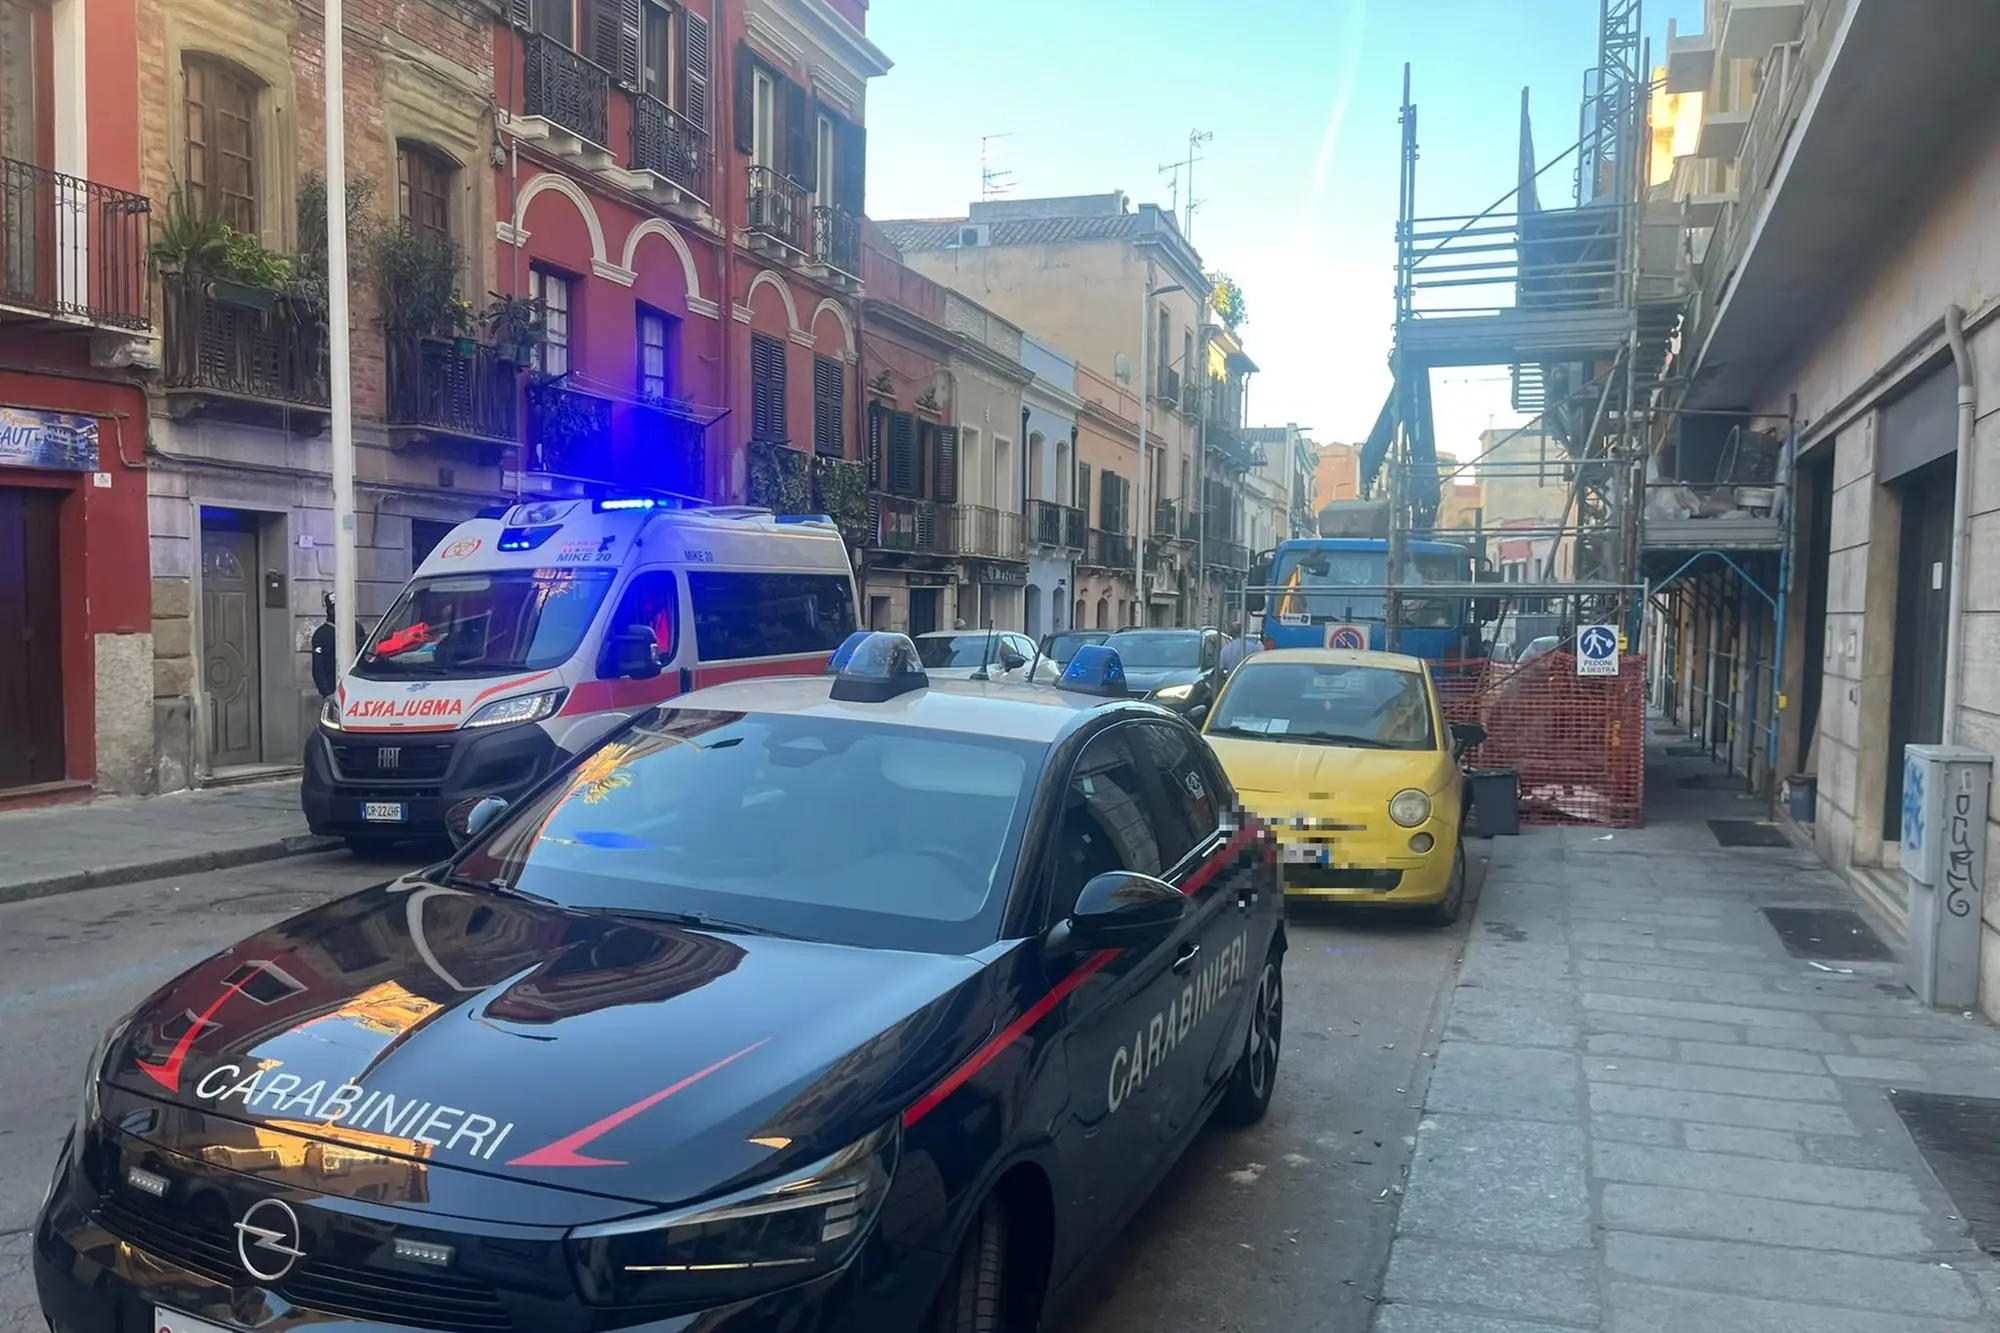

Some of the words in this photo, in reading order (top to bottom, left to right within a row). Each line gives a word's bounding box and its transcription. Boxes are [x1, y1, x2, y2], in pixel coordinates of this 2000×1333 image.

[0, 425, 40, 448] AUT
[556, 553, 593, 562] MIKE
[595, 553, 612, 562] 20
[684, 550, 704, 562] MIKE
[378, 747, 401, 768] FIAT
[1107, 930, 1248, 1113] CARABINIERI
[195, 1063, 515, 1160] CARABINIERI
